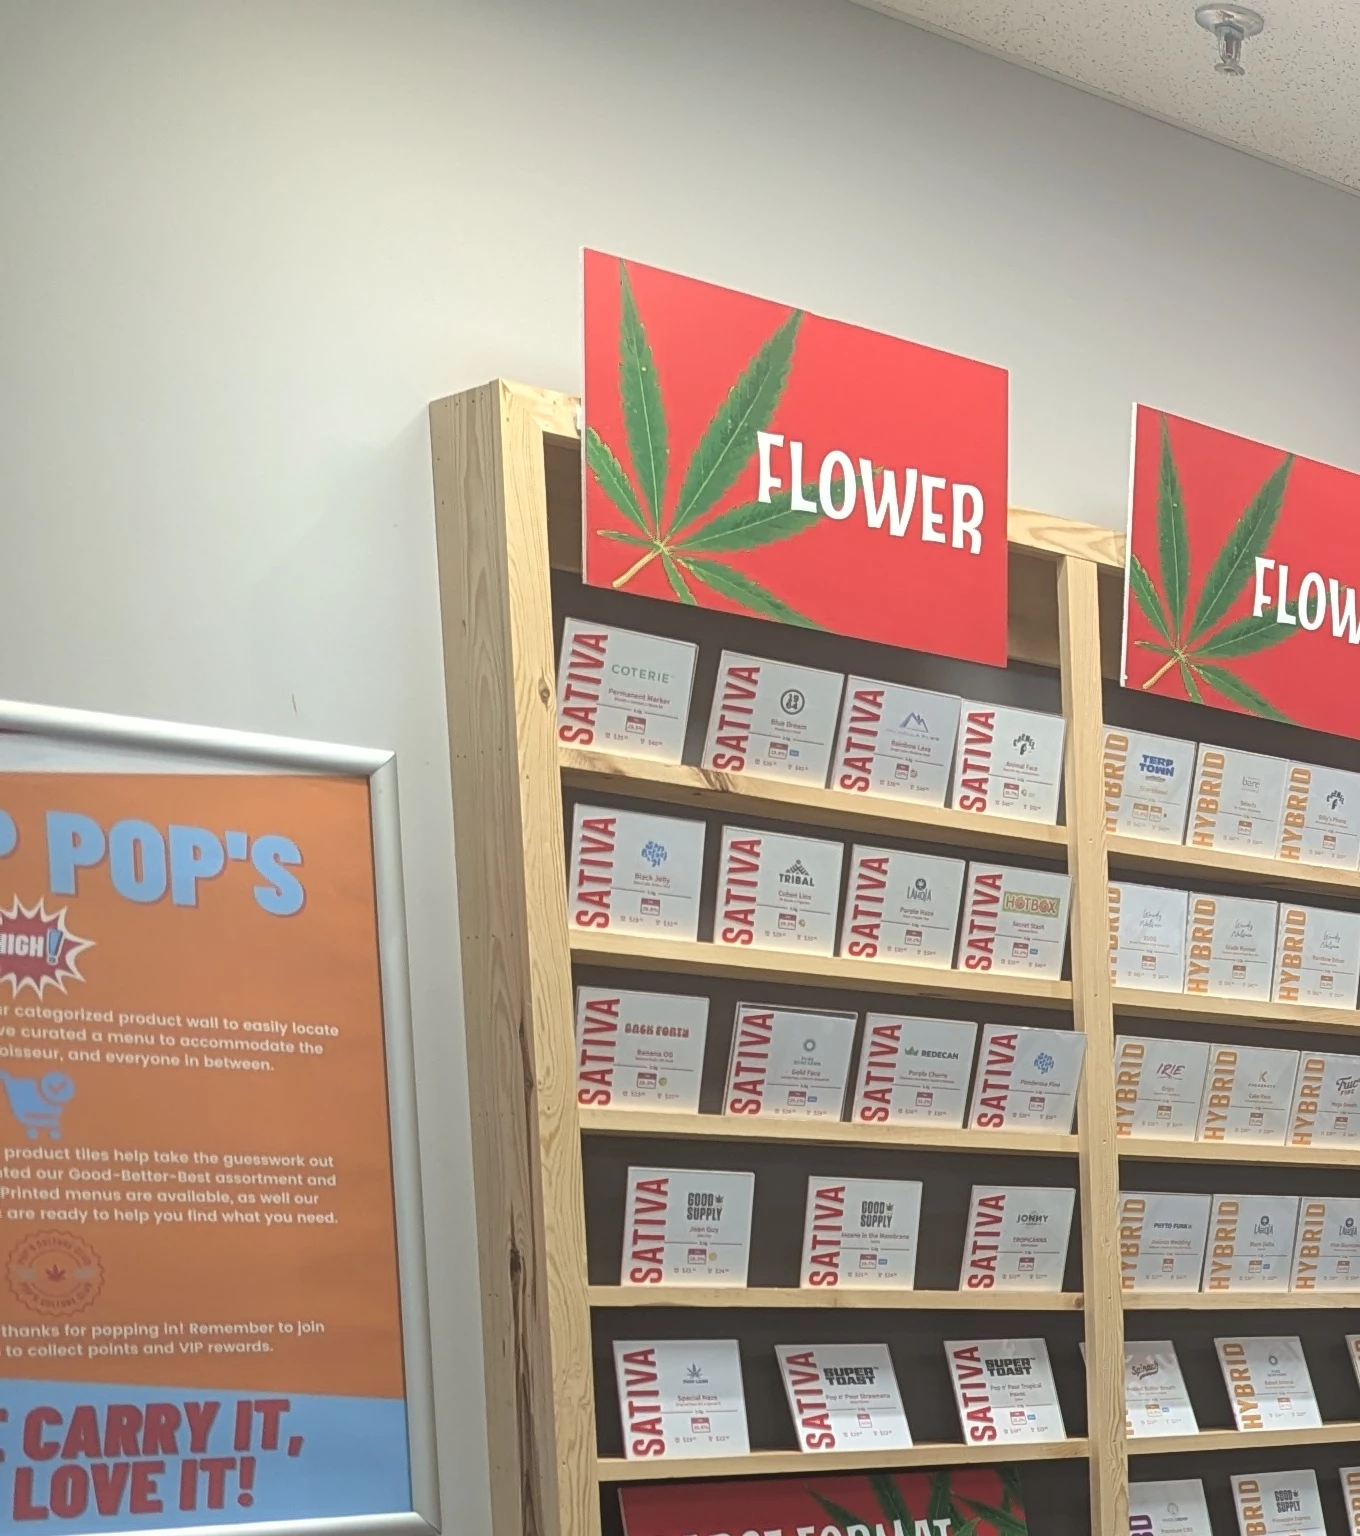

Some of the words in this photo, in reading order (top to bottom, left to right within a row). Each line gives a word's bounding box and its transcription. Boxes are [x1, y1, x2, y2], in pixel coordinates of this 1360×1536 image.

[757, 431, 985, 555] FLOWER
[611, 664, 672, 684] COTERIE
[558, 632, 610, 747] SATIVA
[1139, 753, 1175, 768] TERP
[1139, 764, 1176, 777] TOWN
[1193, 751, 1226, 847] HYBRID
[45, 809, 306, 917] POP'S
[778, 871, 815, 887] TRIBAL
[1004, 896, 1059, 916] HOTBOX
[14, 1005, 114, 1023] categorized
[118, 1012, 182, 1028] product
[186, 1016, 219, 1029] wall
[223, 1018, 239, 1031] to
[243, 1020, 288, 1036] easily
[292, 1022, 339, 1036] locate
[21, 1026, 87, 1042] curated
[91, 1033, 103, 1042] a
[107, 1033, 155, 1046] menu
[159, 1033, 176, 1047] to
[180, 1036, 295, 1053] accommodate
[299, 1041, 324, 1055] the
[1116, 1043, 1146, 1136] HYBRID
[4, 1147, 70, 1162] product
[75, 1147, 109, 1161] tiles
[114, 1149, 149, 1165] help
[154, 1149, 189, 1164] take
[193, 1151, 219, 1164] the
[223, 1153, 305, 1168] guesswork
[309, 1155, 335, 1167] out
[0, 1186, 60, 1200] Printed
[65, 1189, 121, 1201] menus
[126, 1191, 152, 1201] are
[157, 1190, 234, 1205] available,
[237, 1193, 256, 1203] as
[260, 1192, 290, 1204] well
[294, 1195, 320, 1205] our
[687, 1192, 715, 1208] GOOD
[686, 1207, 722, 1223] SUPPLY
[629, 1177, 670, 1285] SATIVA
[1, 1323, 59, 1337] thanks
[65, 1323, 86, 1336] for
[91, 1322, 159, 1340] popping
[189, 1321, 274, 1334] Remember
[278, 1321, 293, 1333] to
[297, 1320, 325, 1336] join
[5, 1344, 23, 1357] to
[27, 1343, 83, 1357] collect
[87, 1342, 138, 1359] points
[143, 1342, 174, 1355] and
[179, 1341, 203, 1354] VIP
[208, 1340, 273, 1353] rewards.
[23, 1400, 221, 1461] CARRY
[233, 1398, 305, 1458] IT,
[13, 1459, 166, 1521] LOVE
[179, 1456, 257, 1512] IT!
